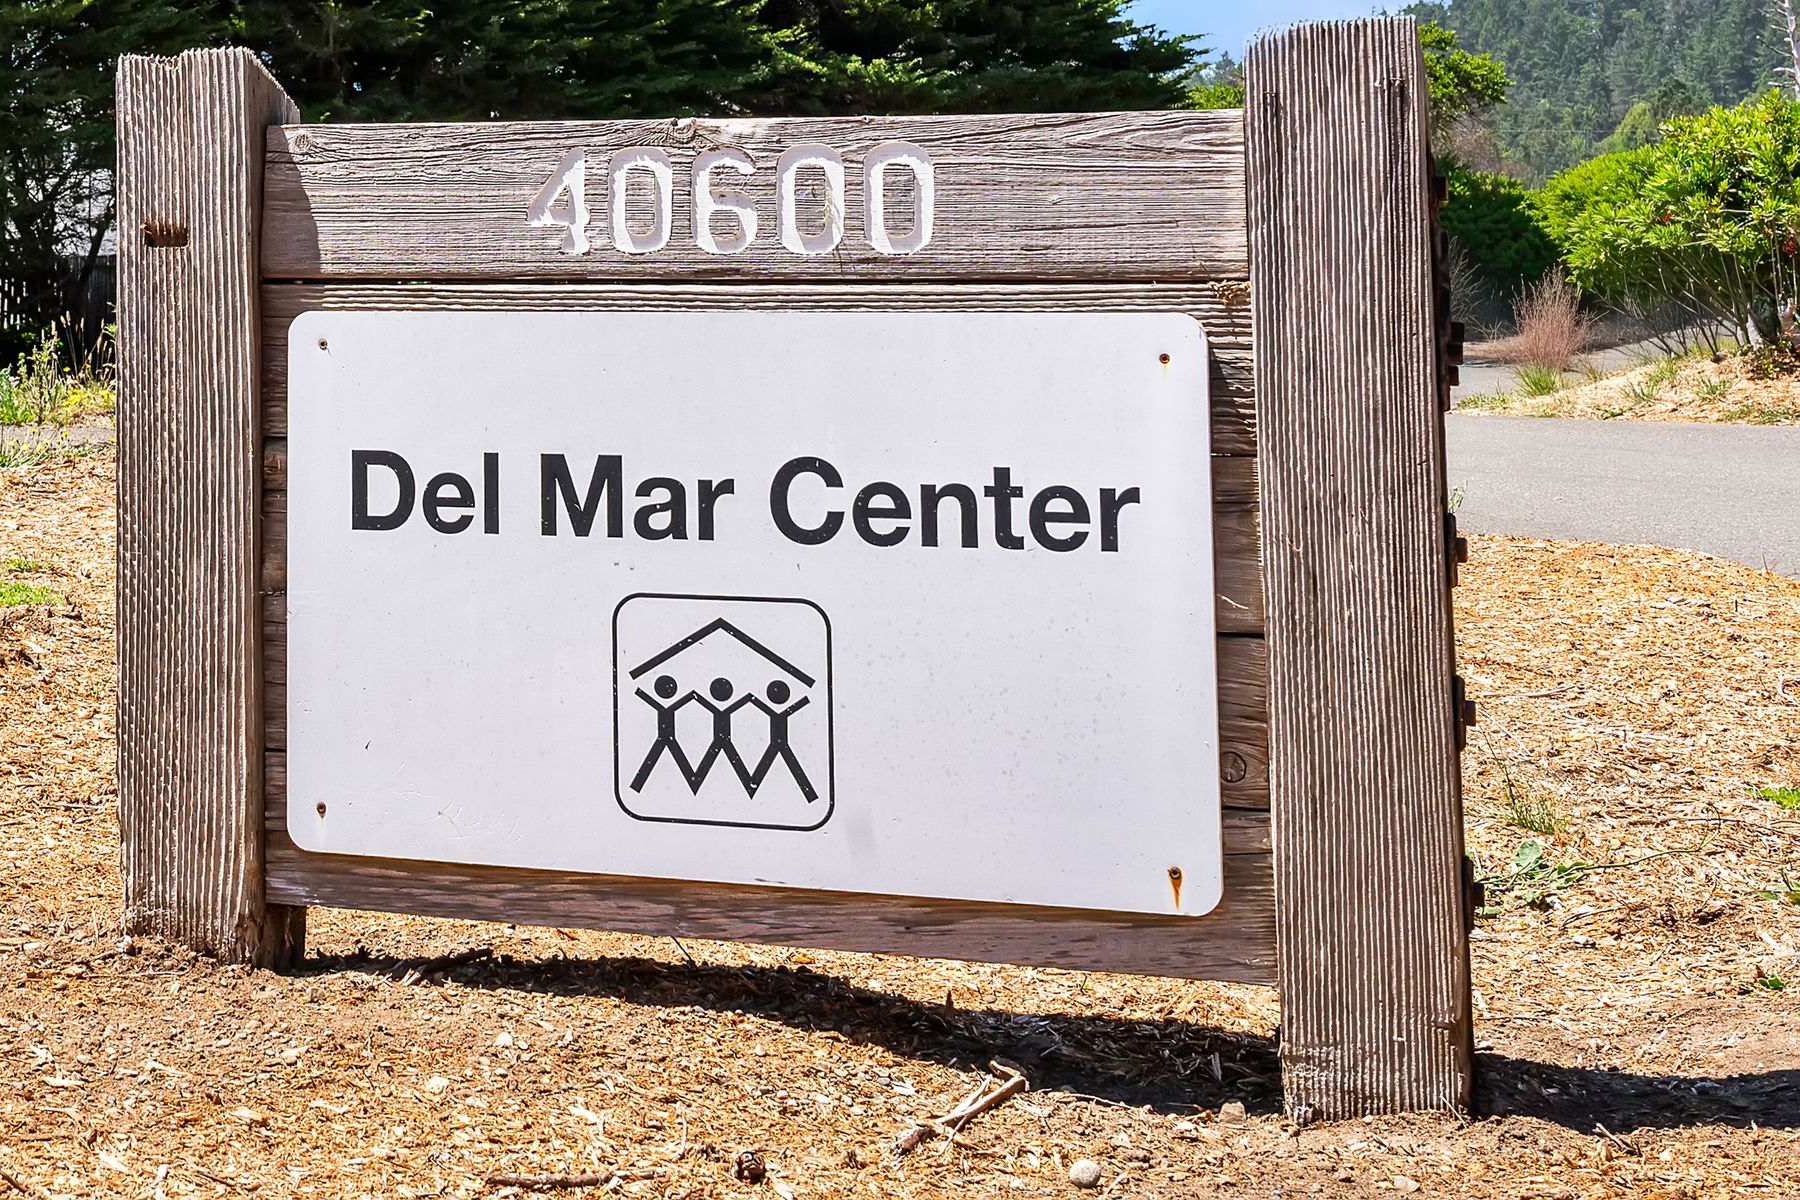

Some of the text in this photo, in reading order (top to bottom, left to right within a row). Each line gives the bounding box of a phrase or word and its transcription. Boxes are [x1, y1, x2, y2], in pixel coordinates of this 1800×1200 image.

[526, 141, 935, 255] 40600
[351, 449, 1141, 553] Del Mar Center
